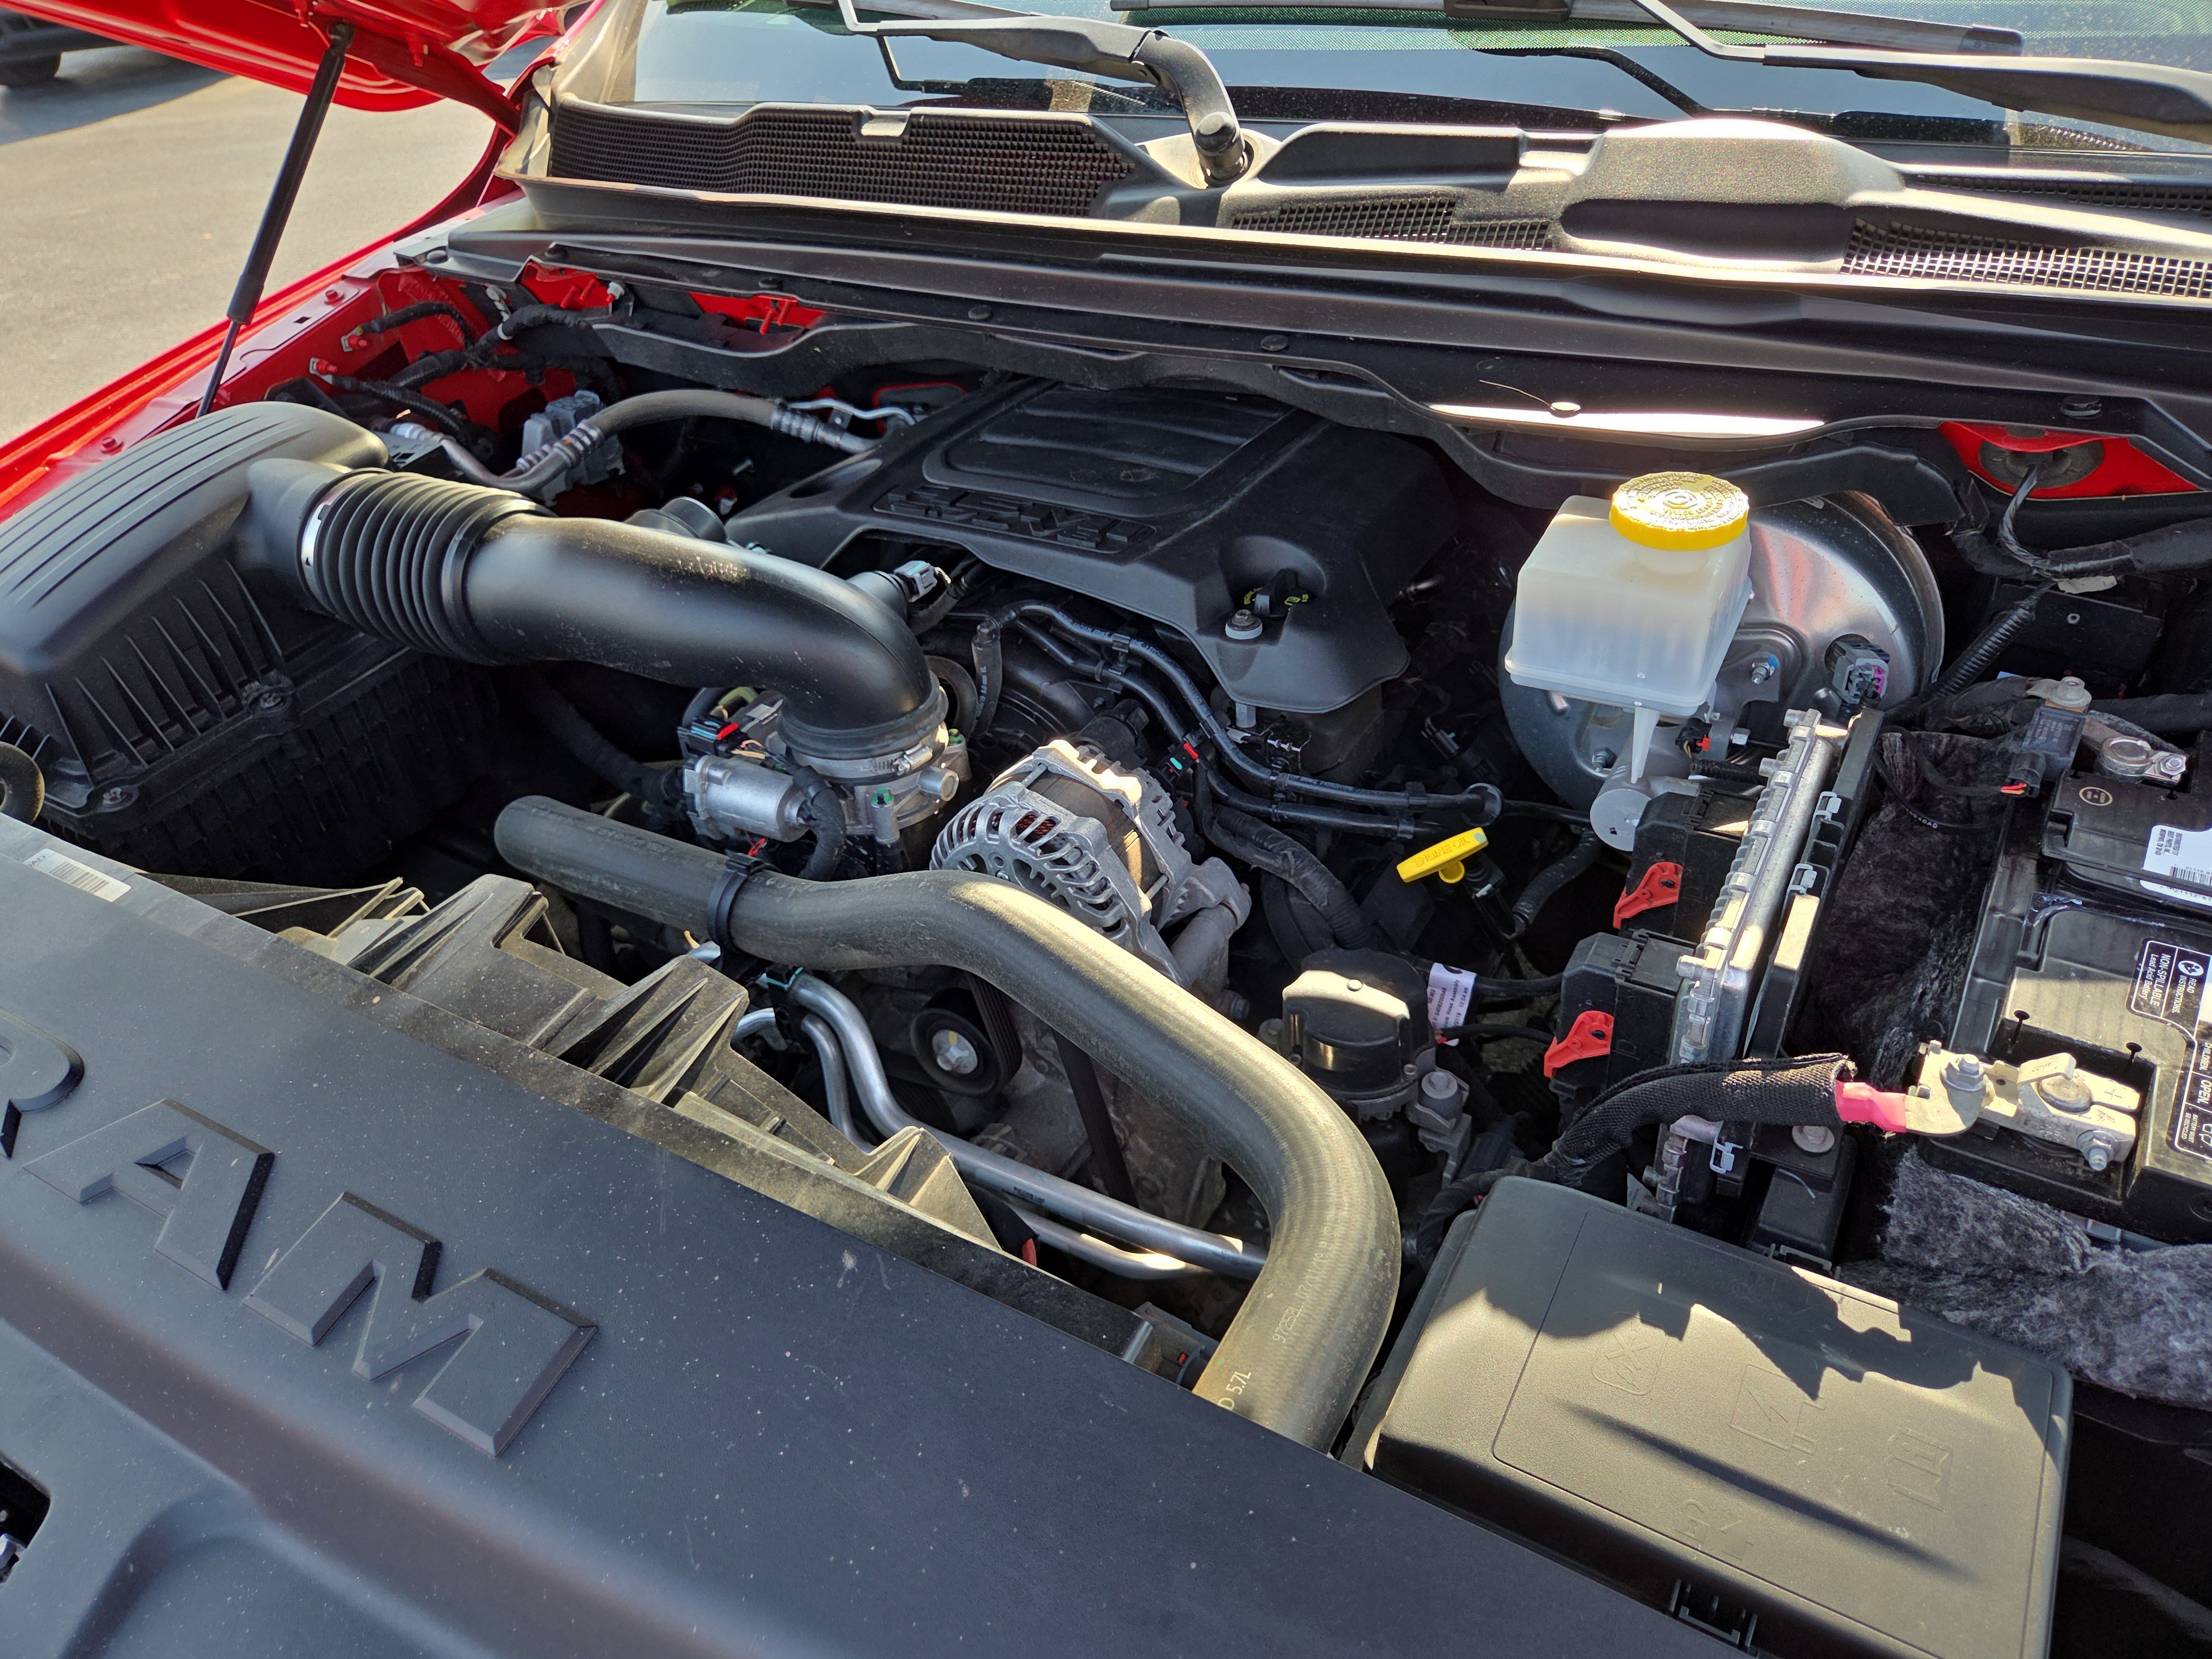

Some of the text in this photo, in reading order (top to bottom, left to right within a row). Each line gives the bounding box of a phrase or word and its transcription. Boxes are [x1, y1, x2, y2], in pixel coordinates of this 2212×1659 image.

[1415, 837, 1470, 867] ENGINE OIL
[2139, 954, 2159, 999] Lead Acid Battery
[2150, 954, 2171, 1006] NON-SPILLABLE
[2187, 978, 2197, 994] READ
[1450, 979, 1460, 1001] Assembly
[2199, 1042, 2212, 1071] CHILDREN.
[2197, 1079, 2212, 1105] OPEN.
[2190, 1114, 2198, 1131] BATTERY
[1225, 1371, 1252, 1396] 5.7L
